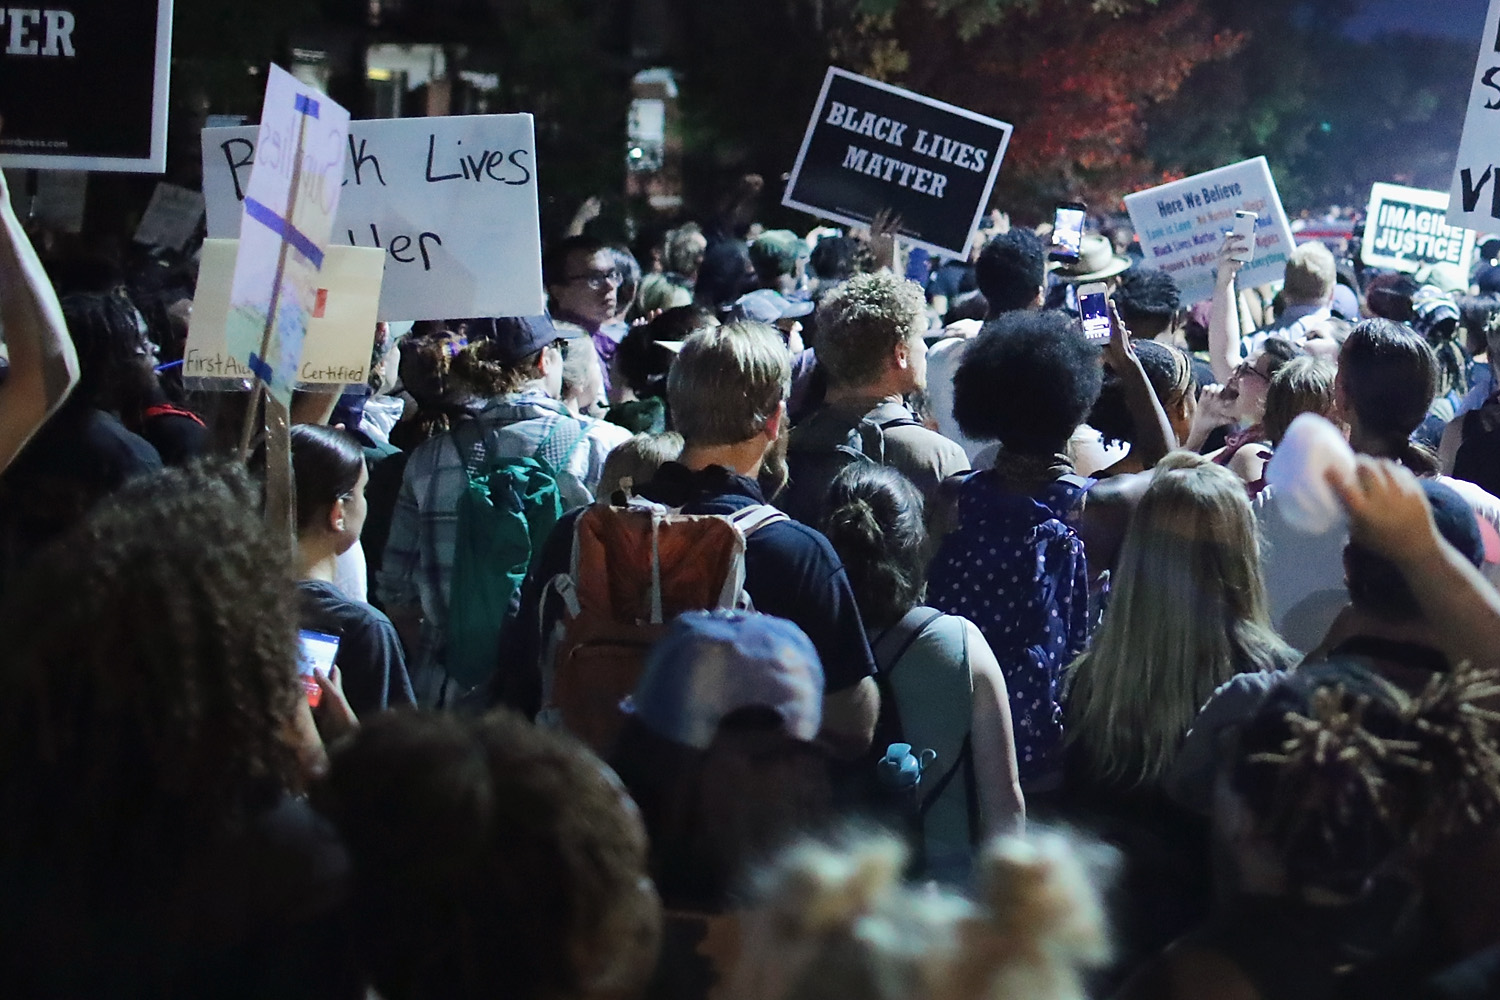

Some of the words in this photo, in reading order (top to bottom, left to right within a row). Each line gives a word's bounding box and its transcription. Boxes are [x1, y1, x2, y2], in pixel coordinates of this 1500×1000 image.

[826, 101, 908, 147] BLACK
[911, 129, 989, 174] LIVES
[426, 134, 530, 185] Lives
[841, 145, 948, 199] MATTER
[1157, 201, 1184, 217] Here
[1183, 191, 1202, 208] We
[1201, 182, 1242, 204] Believe
[1379, 204, 1464, 240] IMAGINE
[1375, 227, 1461, 262] JUSTICE
[186, 349, 223, 375] First
[302, 362, 364, 382] Certified
